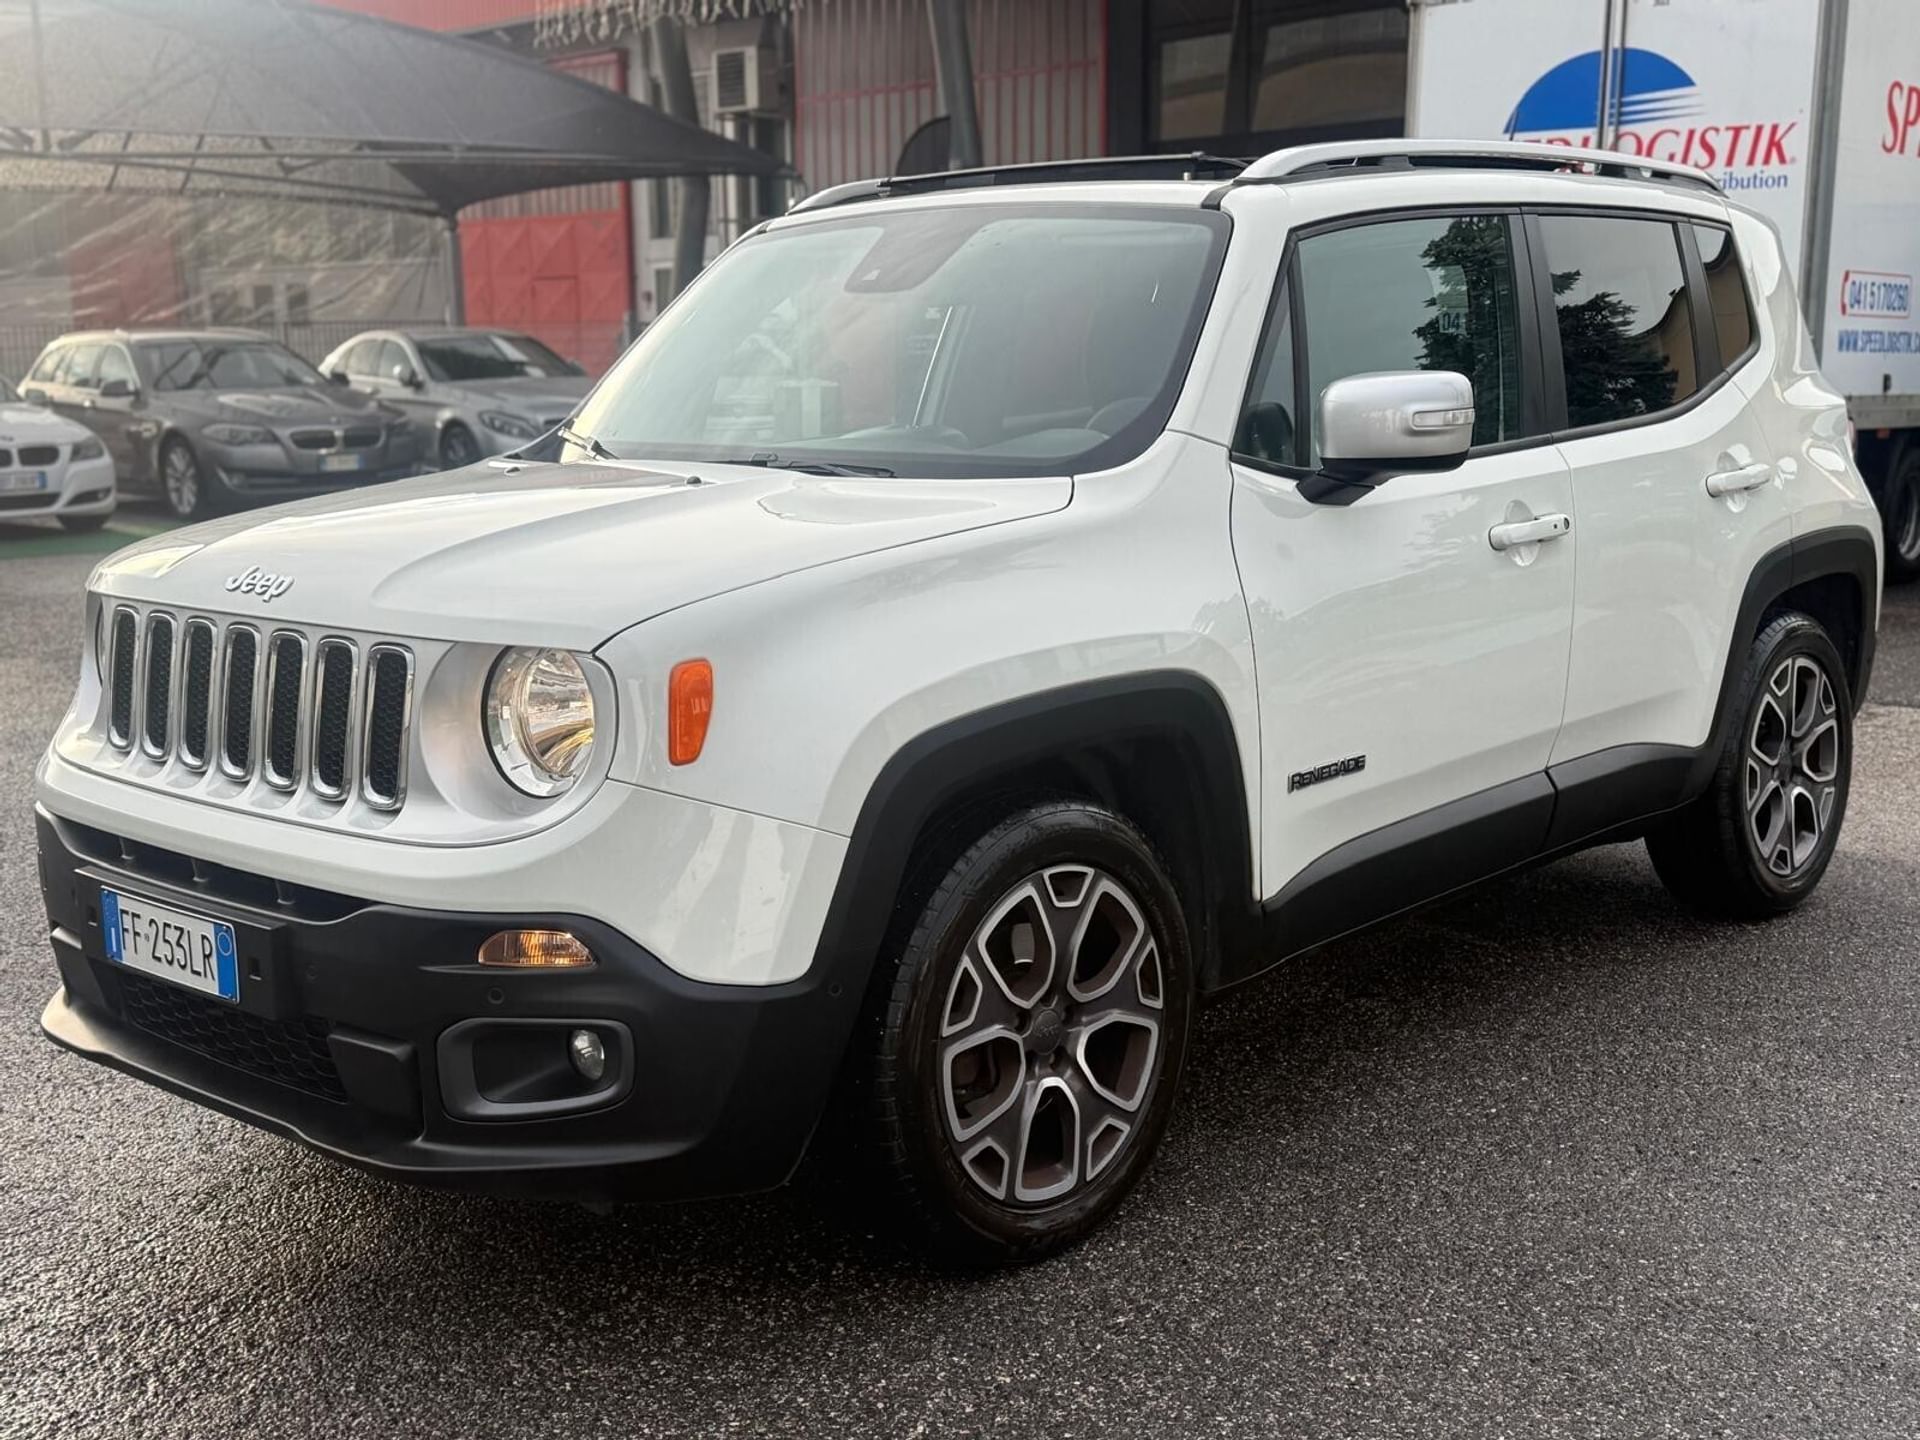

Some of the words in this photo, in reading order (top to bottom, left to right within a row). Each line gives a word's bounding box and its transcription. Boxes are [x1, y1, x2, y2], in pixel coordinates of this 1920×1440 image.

[1882, 81, 1920, 157] SP
[225, 565, 295, 603] Jeep
[1287, 754, 1366, 794] RENEGADE
